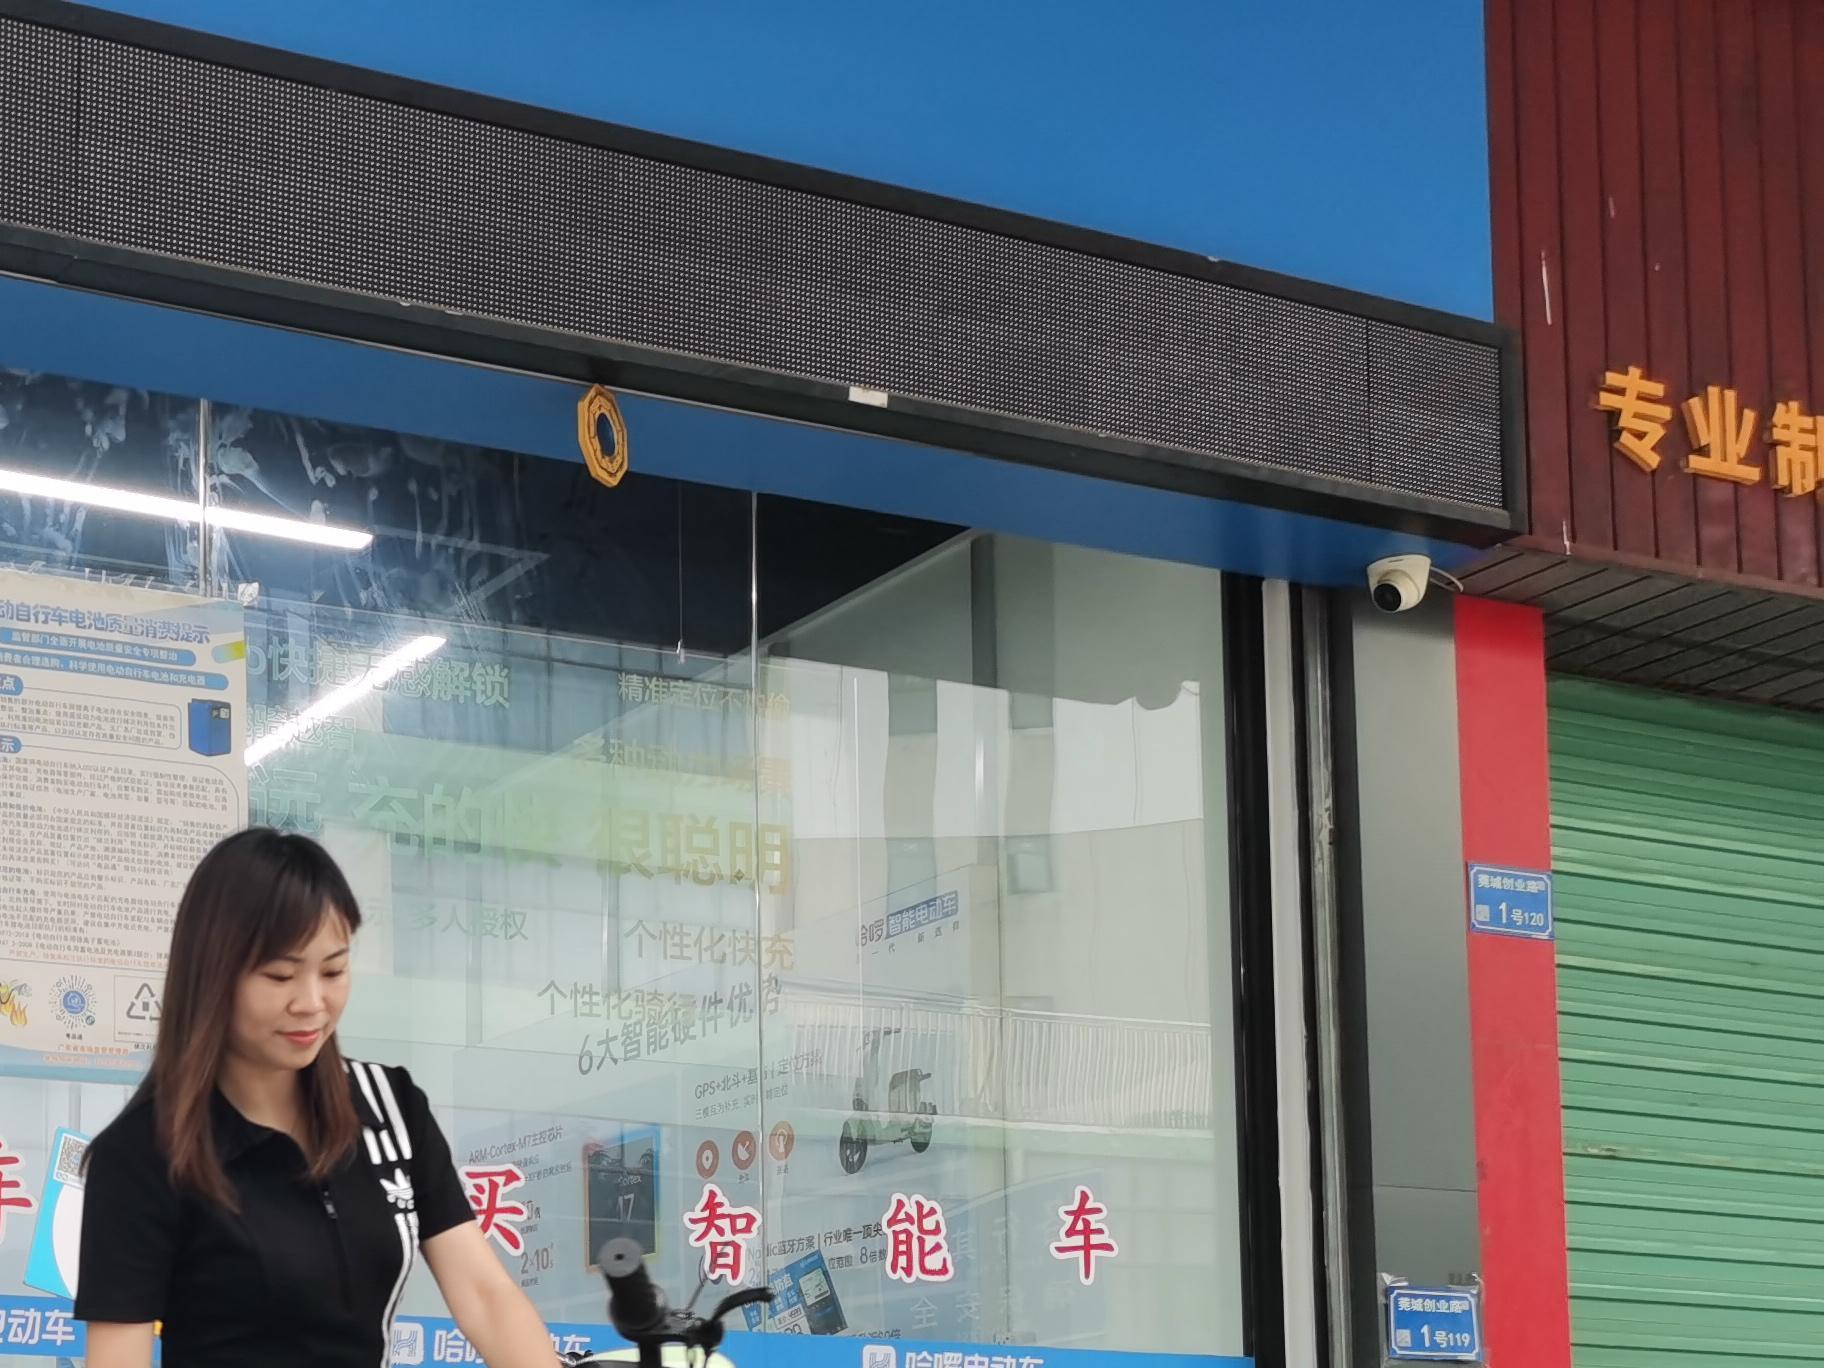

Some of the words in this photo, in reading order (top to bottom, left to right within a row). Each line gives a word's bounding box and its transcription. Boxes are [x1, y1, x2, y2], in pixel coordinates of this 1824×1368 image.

[465, 1168, 524, 1250] 买
[689, 1189, 757, 1281] 智
[886, 1198, 950, 1279] 能
[1053, 1190, 1115, 1280] 车
